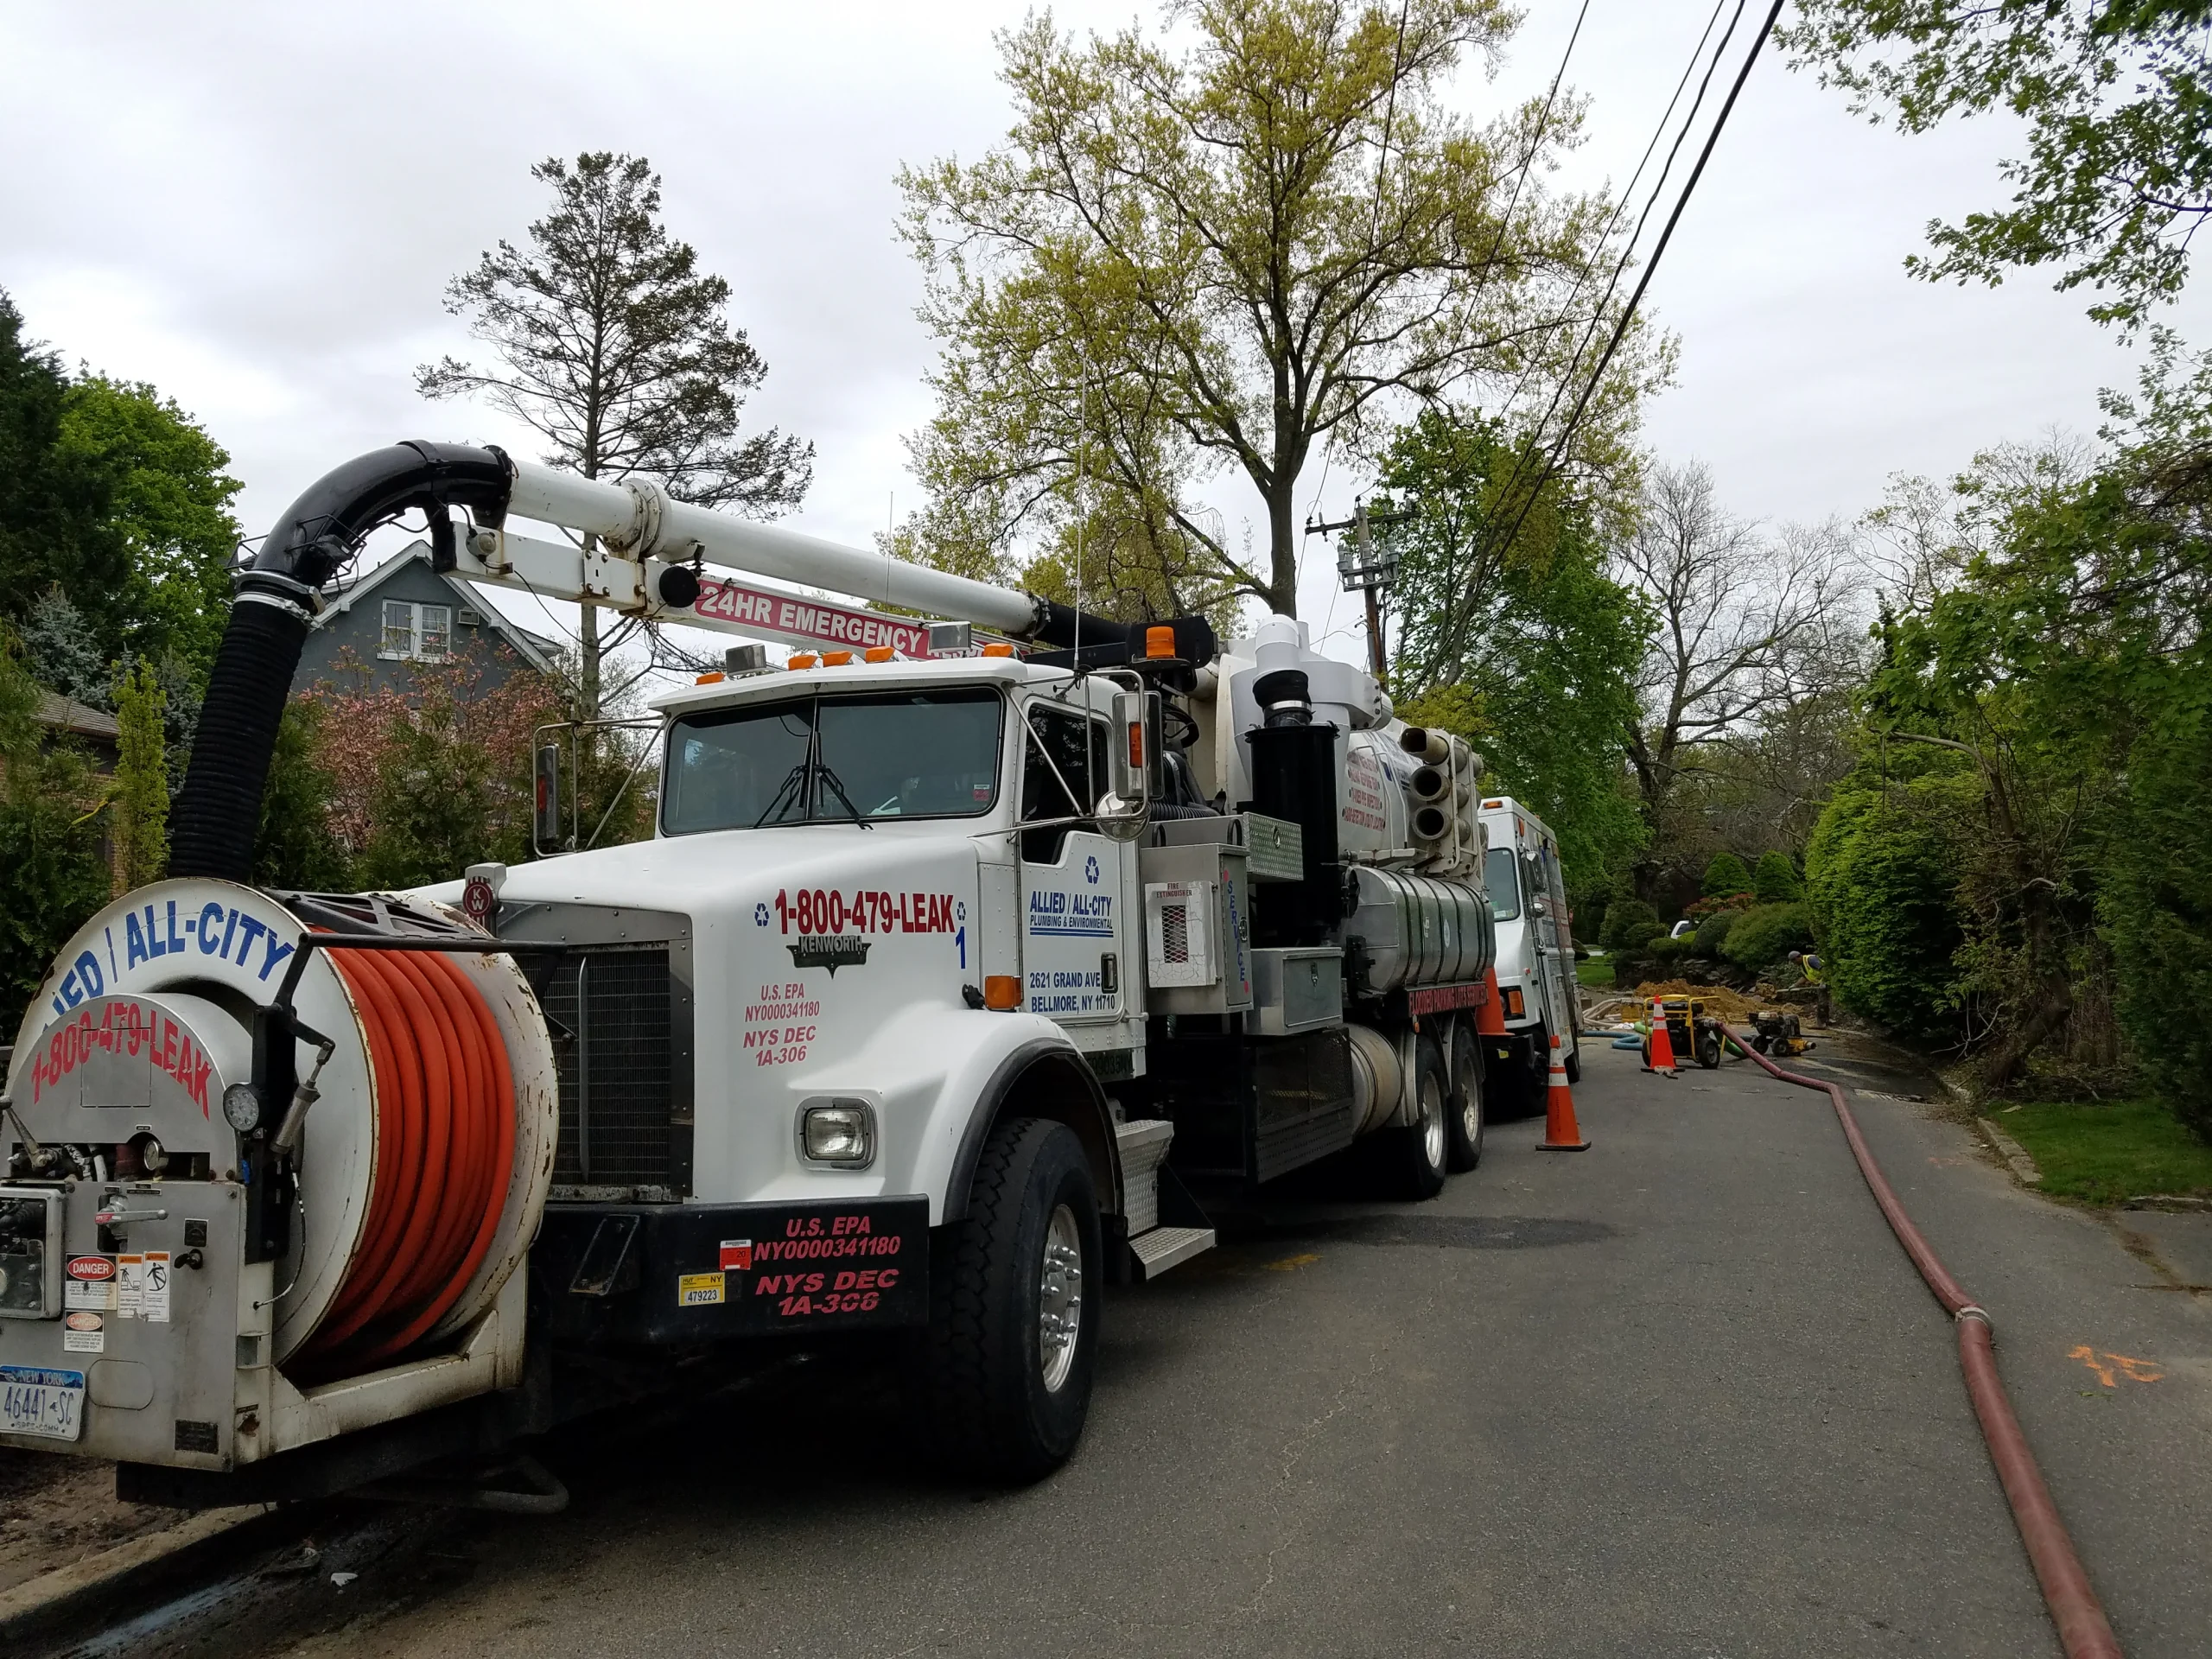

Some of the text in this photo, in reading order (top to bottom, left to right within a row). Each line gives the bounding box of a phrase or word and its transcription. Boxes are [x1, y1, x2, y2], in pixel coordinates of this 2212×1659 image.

[701, 585, 923, 653] 24HR EMERGENCY
[1029, 890, 1066, 914] ALLIED
[1072, 893, 1113, 917] ALL-CITY
[1156, 889, 1192, 899] EXTINGUISHER
[774, 888, 956, 935] 1-800-479-LEAK
[1029, 914, 1062, 927] PLUMBING
[1069, 917, 1113, 930] ENVIRONMENTAL
[125, 900, 296, 982] ALL-CITY
[1227, 880, 1246, 982] SERVICE
[798, 935, 862, 953] KENWORTH
[955, 925, 966, 969] 1
[1029, 971, 1051, 988] 2621
[1053, 971, 1083, 988] GRAND
[760, 983, 804, 1001] U.S. EPA
[745, 1001, 820, 1022] NY0000341180
[1031, 995, 1116, 1014] BELLMORE, NY 11710
[743, 1026, 817, 1048] NYS DEC
[31, 1002, 213, 1121] 1-800-479-LEAK
[754, 1046, 807, 1067] 1A-306
[785, 1216, 871, 1237] U.S. EPA
[753, 1236, 901, 1262] NY0000341180
[73, 1262, 109, 1274] DANGER
[755, 1268, 899, 1295] NYS DEC
[687, 1289, 717, 1303] 479223
[70, 1317, 98, 1327] DANGER
[19, 1370, 66, 1387] NEW YORK
